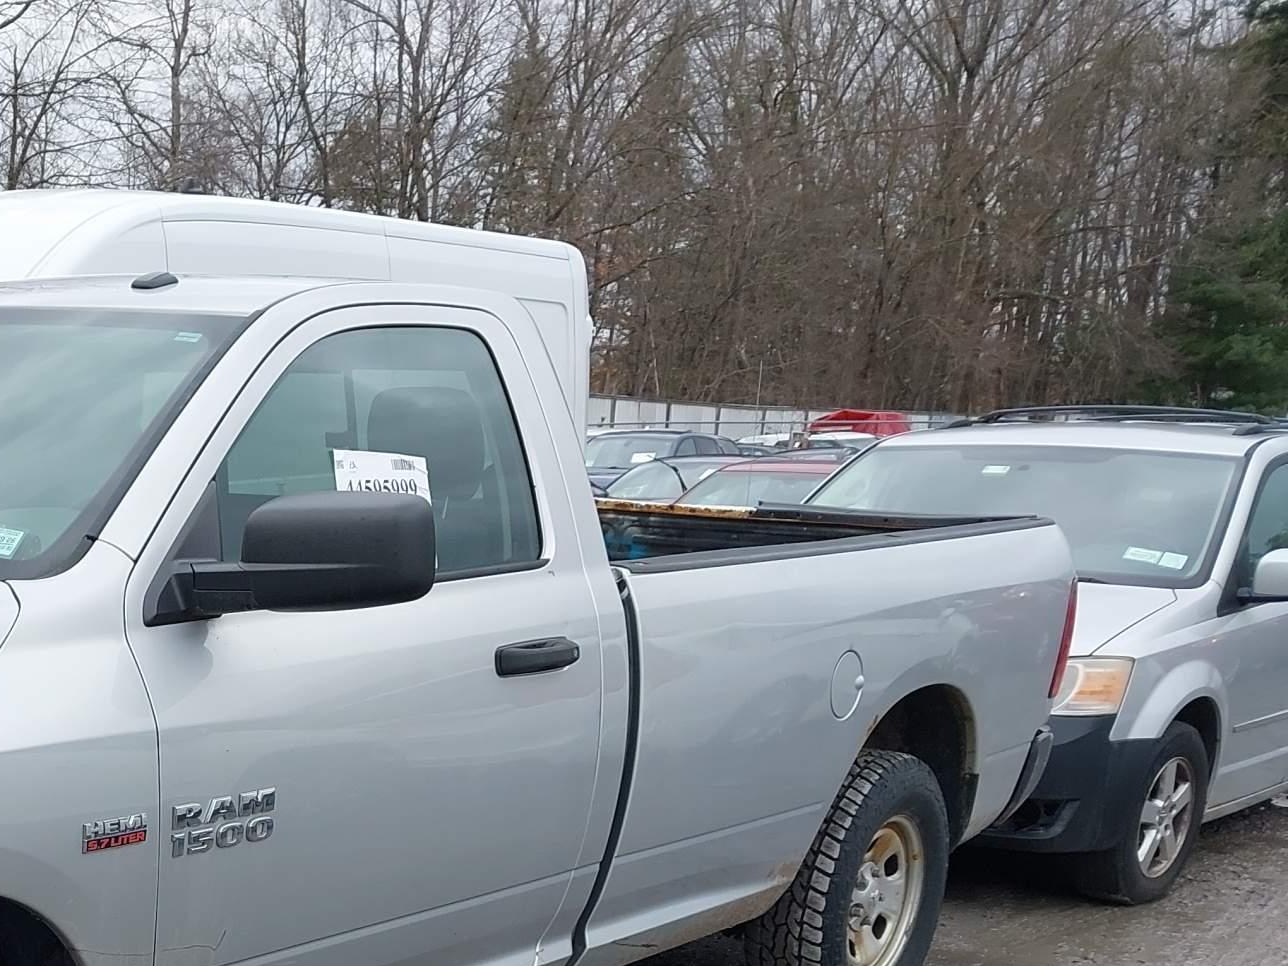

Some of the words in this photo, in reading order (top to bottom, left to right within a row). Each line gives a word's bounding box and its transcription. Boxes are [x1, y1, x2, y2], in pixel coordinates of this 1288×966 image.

[83, 812, 148, 839] HEMI
[171, 787, 276, 830] RAM
[171, 816, 274, 858] 1500
